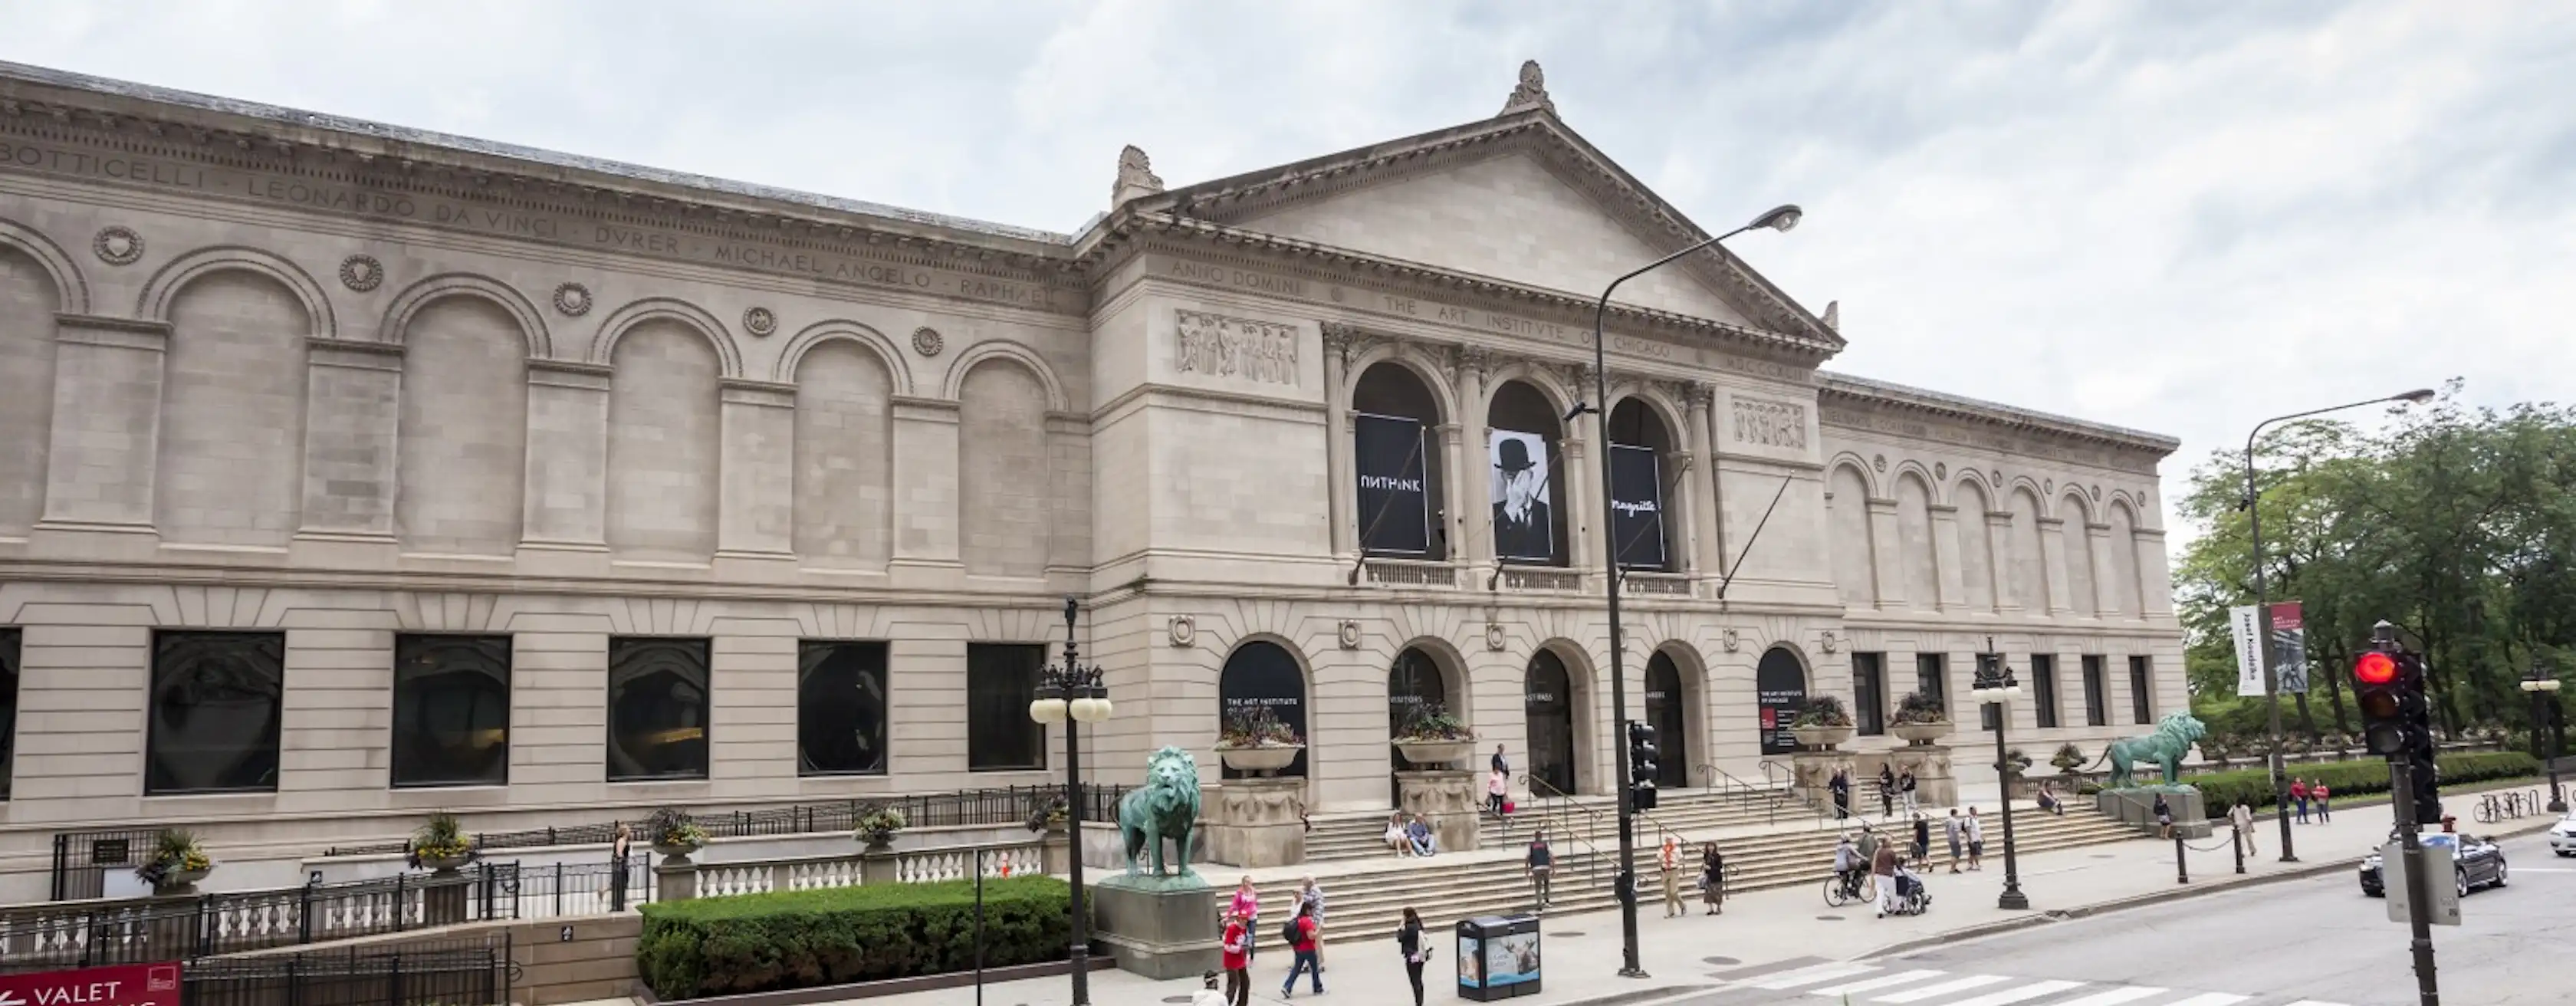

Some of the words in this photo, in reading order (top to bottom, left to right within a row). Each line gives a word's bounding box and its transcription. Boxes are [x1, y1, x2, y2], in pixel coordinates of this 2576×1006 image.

[248, 177, 415, 216] LEONARDO
[435, 204, 471, 225] DA
[485, 211, 557, 237] VINCI
[715, 245, 823, 274] MICHAEL
[836, 261, 930, 289] ANGELO
[961, 279, 1056, 305] RAPHAEL
[1173, 261, 1224, 282] ANNO
[1234, 271, 1300, 294] DOMINI
[1383, 296, 1418, 315] THE
[1438, 307, 1468, 324] ART
[34, 981, 121, 1005] VALET
